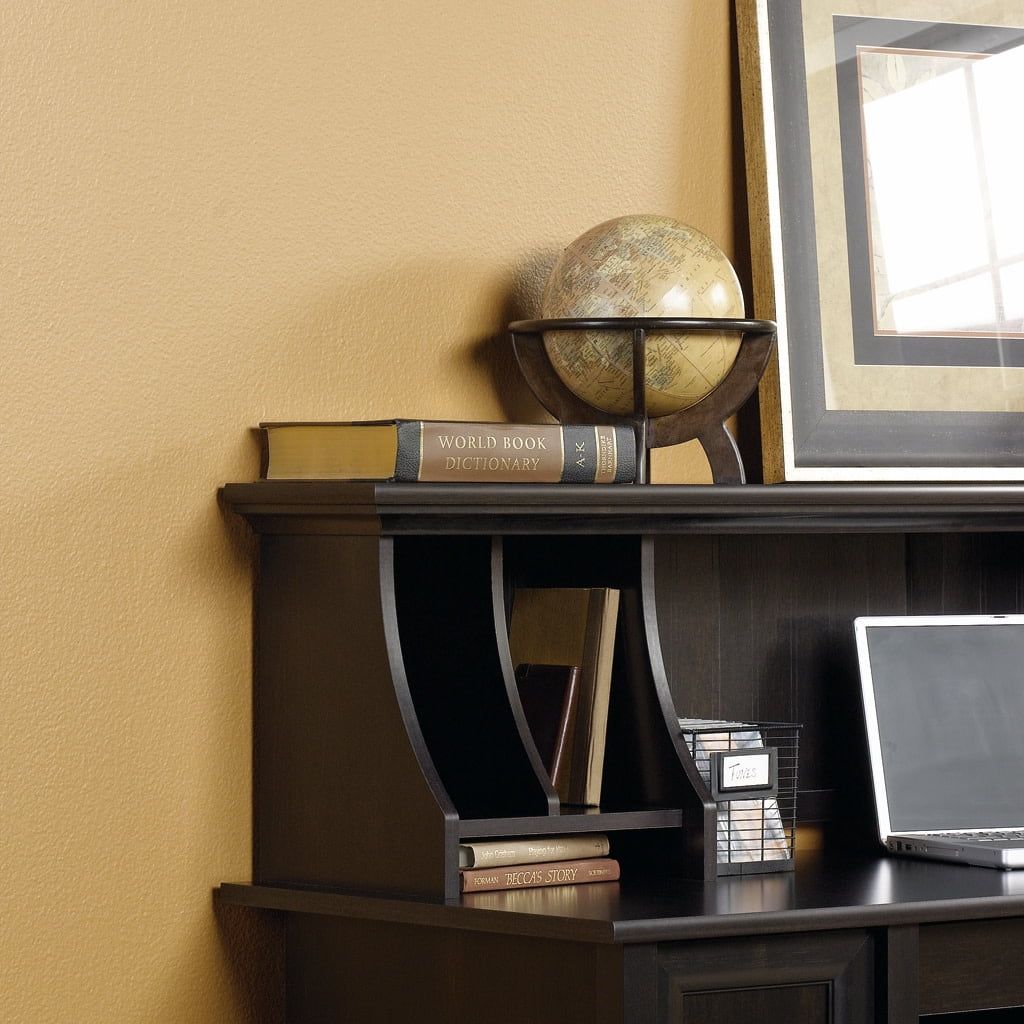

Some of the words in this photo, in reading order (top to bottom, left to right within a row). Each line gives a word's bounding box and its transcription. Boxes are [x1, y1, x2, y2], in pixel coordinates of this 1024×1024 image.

[438, 435, 497, 450] WORLD
[503, 436, 547, 450] BOOK
[575, 441, 586, 468] A-K
[445, 456, 541, 471] DICTIONARY
[474, 876, 499, 886] FORMAN
[504, 868, 543, 886] BECCA'S
[545, 867, 578, 883] STORY
